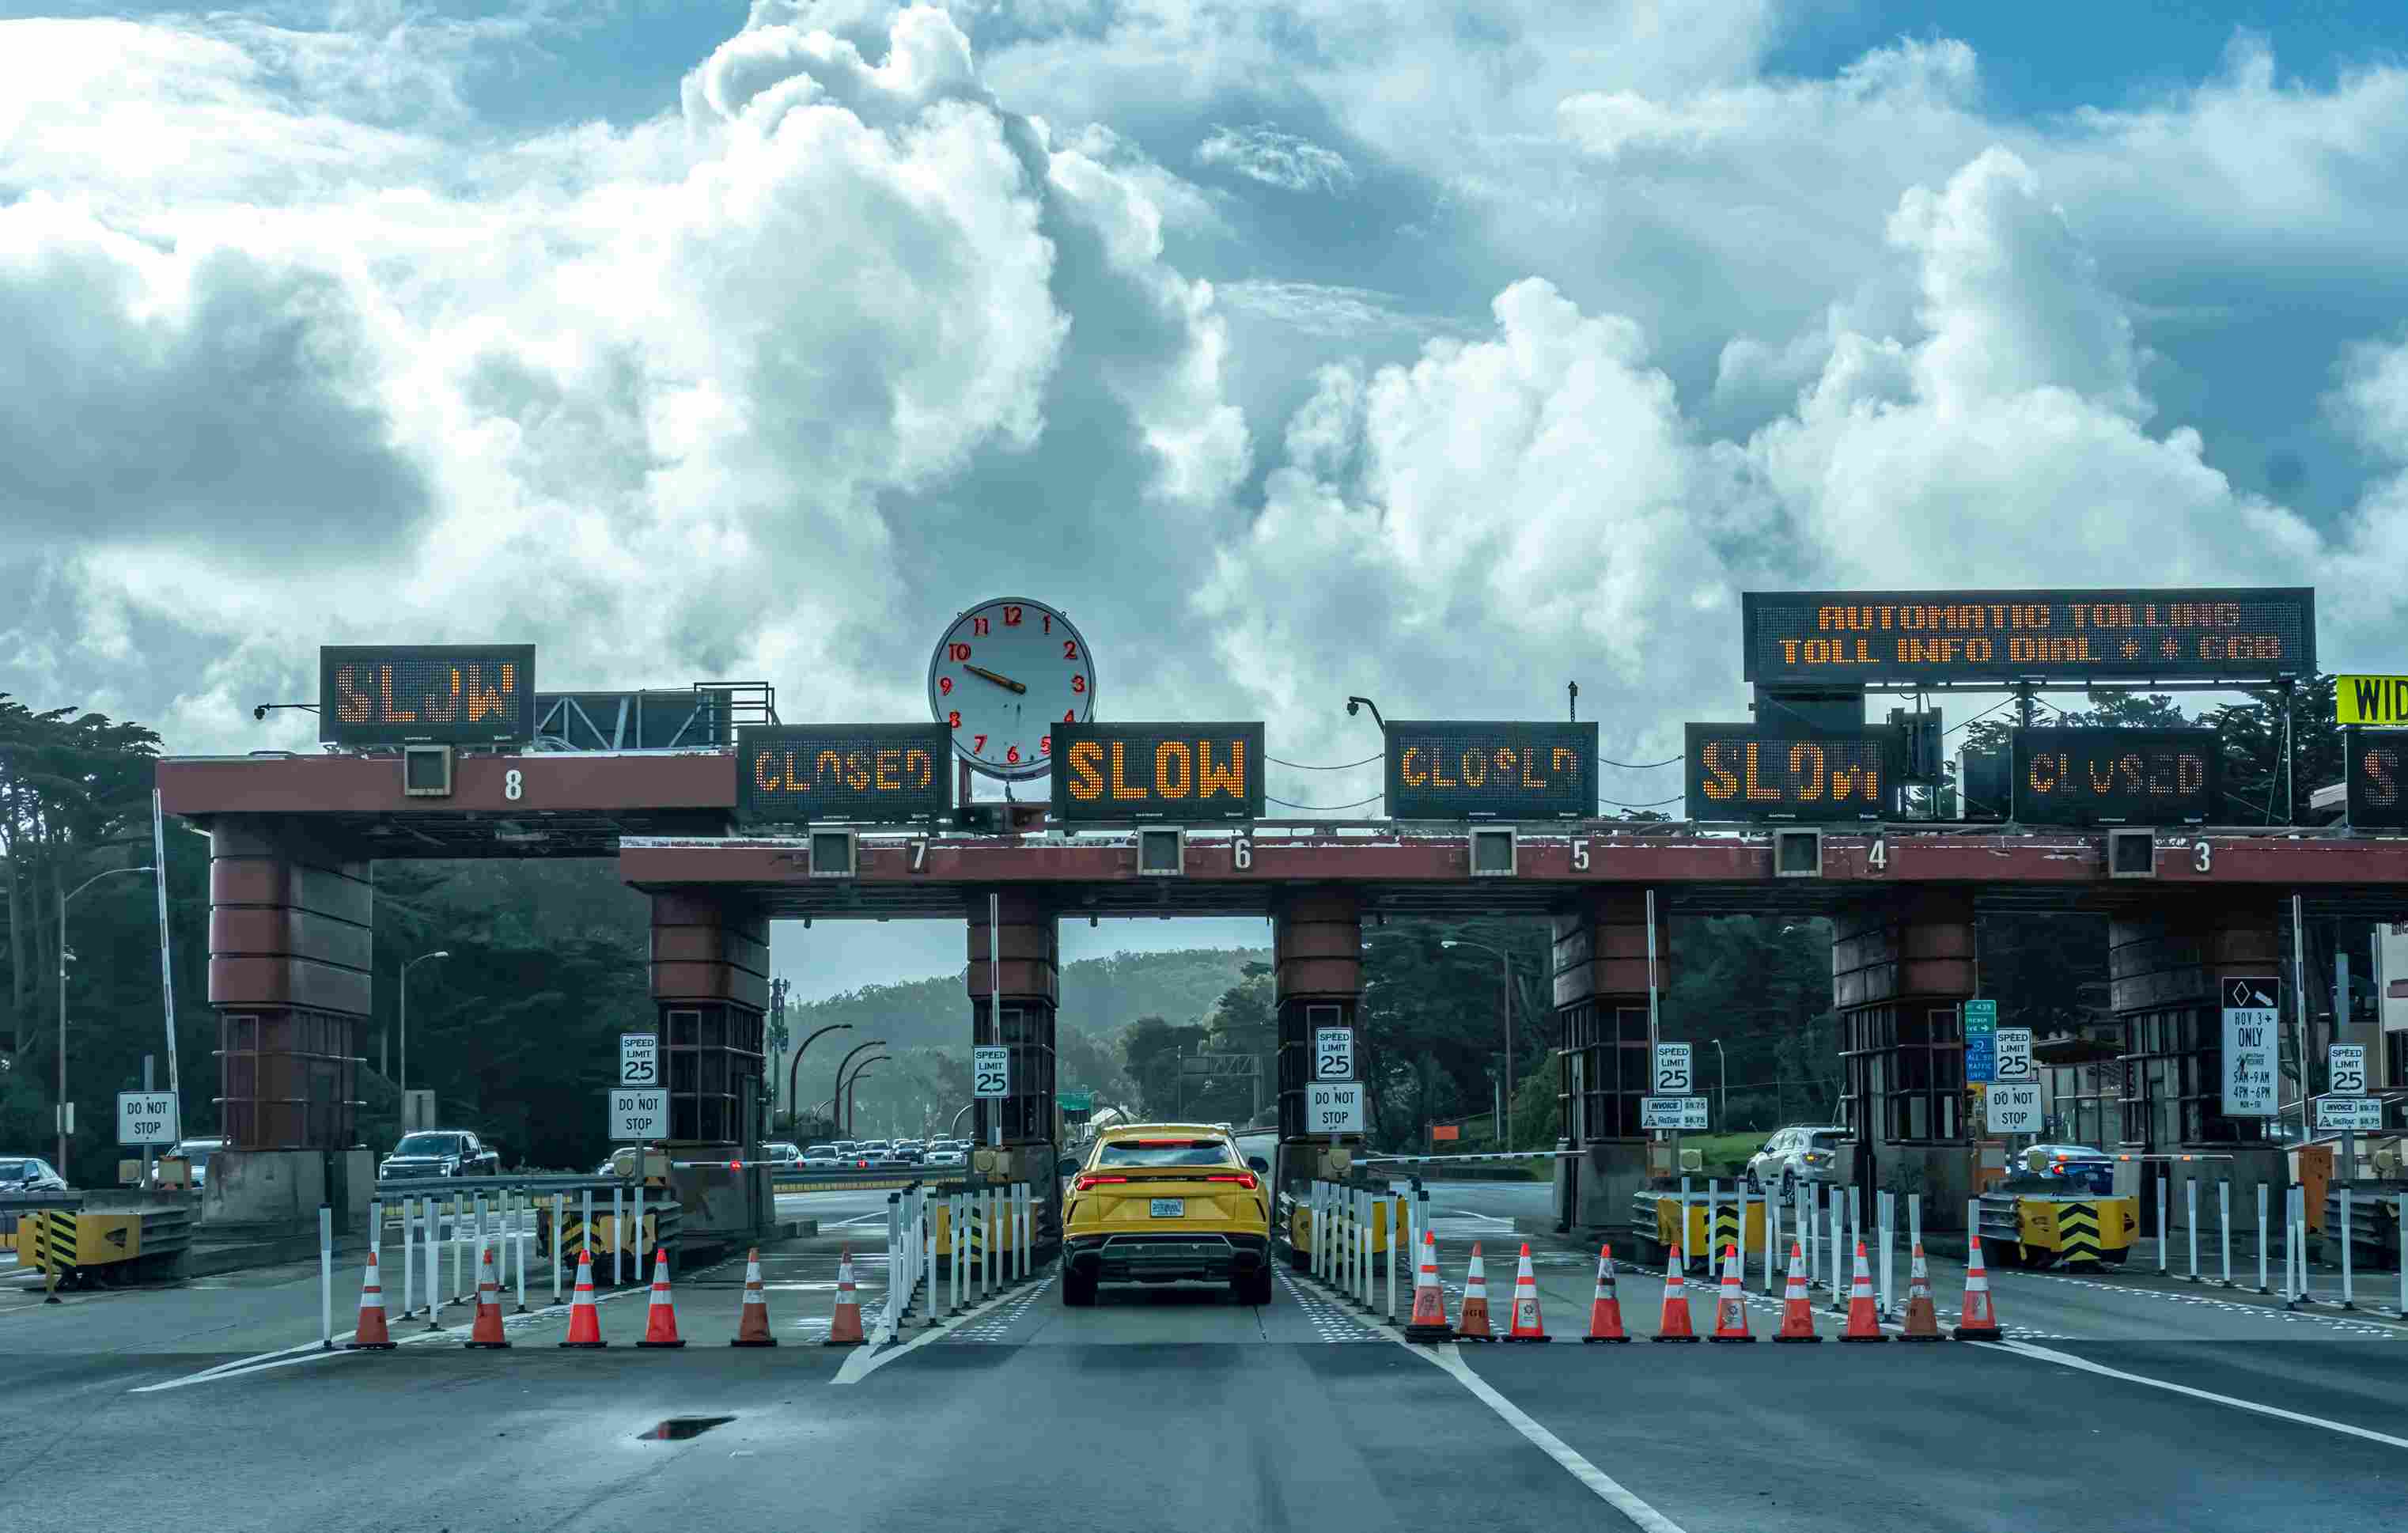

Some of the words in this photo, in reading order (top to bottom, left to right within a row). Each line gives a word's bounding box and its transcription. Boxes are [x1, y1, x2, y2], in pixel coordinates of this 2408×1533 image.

[1004, 607, 1022, 626] 12
[1043, 615, 1051, 634] 1
[1819, 604, 2050, 630] AUTOMATIC
[974, 618, 989, 636] 11
[949, 644, 971, 661] 10
[1063, 642, 1077, 660] 2
[1779, 639, 1880, 664] TOLL
[1898, 638, 1992, 663] INFO
[2010, 637, 2101, 663] DIAL
[940, 678, 952, 695] 9
[1072, 676, 1085, 693] 3
[949, 712, 961, 729] 8
[1064, 710, 1075, 722] 4
[975, 735, 987, 754] 7
[1041, 736, 1051, 754] 5
[1007, 747, 1020, 763] 6
[1069, 740, 1245, 800] SLOW
[505, 770, 521, 801] 8
[911, 841, 926, 869] 7
[1235, 838, 1251, 869] 6
[1574, 841, 1589, 869] 5
[1868, 840, 1887, 869] 4
[2195, 842, 2210, 872] 3
[2235, 1013, 2252, 1026] HOV
[624, 1039, 654, 1047] SPEED
[1997, 1033, 2028, 1042] SPEED
[2239, 1028, 2263, 1047] ONLY
[975, 1050, 1006, 1059] SPEED
[2001, 1044, 2025, 1053] LIMIT
[2331, 1049, 2362, 1058] SPEED
[625, 1061, 653, 1080] 25
[1320, 1055, 1350, 1074] 25
[1999, 1056, 2028, 1075] 25
[977, 1073, 1006, 1092] 25
[1660, 1070, 1688, 1088] 25
[2334, 1071, 2363, 1091] 25
[619, 1099, 633, 1111] DO
[638, 1099, 659, 1111] NOT
[1316, 1092, 1329, 1104] DO
[1335, 1092, 1354, 1104] NOT
[1993, 1092, 2008, 1105] DO
[2013, 1092, 2034, 1104] NOT
[127, 1102, 142, 1114] DO
[147, 1102, 167, 1114] NOT
[626, 1118, 652, 1130] STOP
[1322, 1111, 1349, 1124] STOP
[2001, 1112, 2027, 1124] STOP
[134, 1122, 161, 1134] STOP
